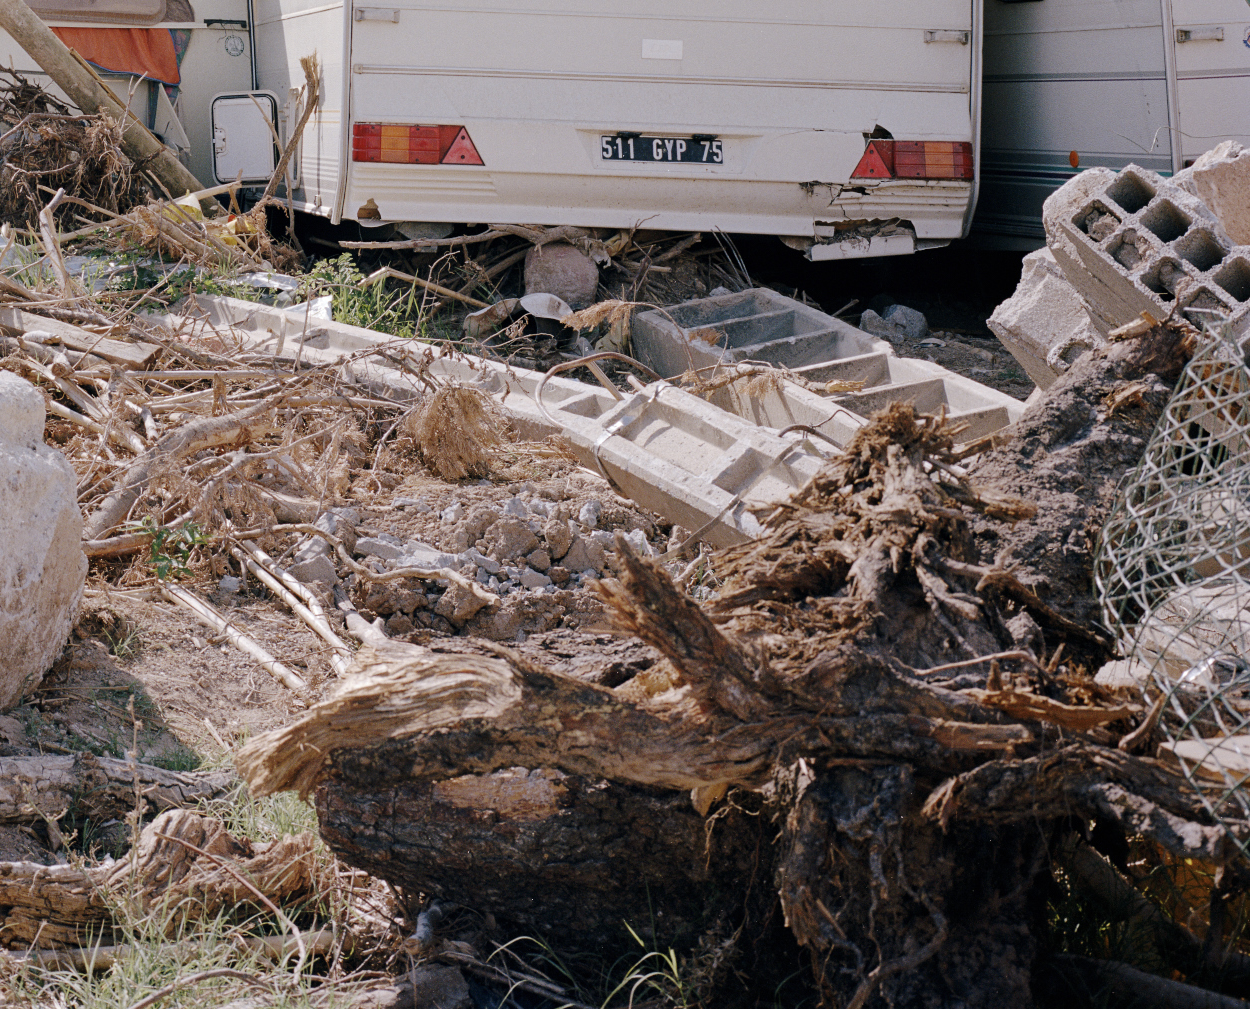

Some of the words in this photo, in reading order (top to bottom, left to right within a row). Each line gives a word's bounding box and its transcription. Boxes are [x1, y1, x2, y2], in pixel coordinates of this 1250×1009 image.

[601, 136, 635, 160] 511
[652, 138, 688, 161] GYP
[700, 140, 723, 163] 75
